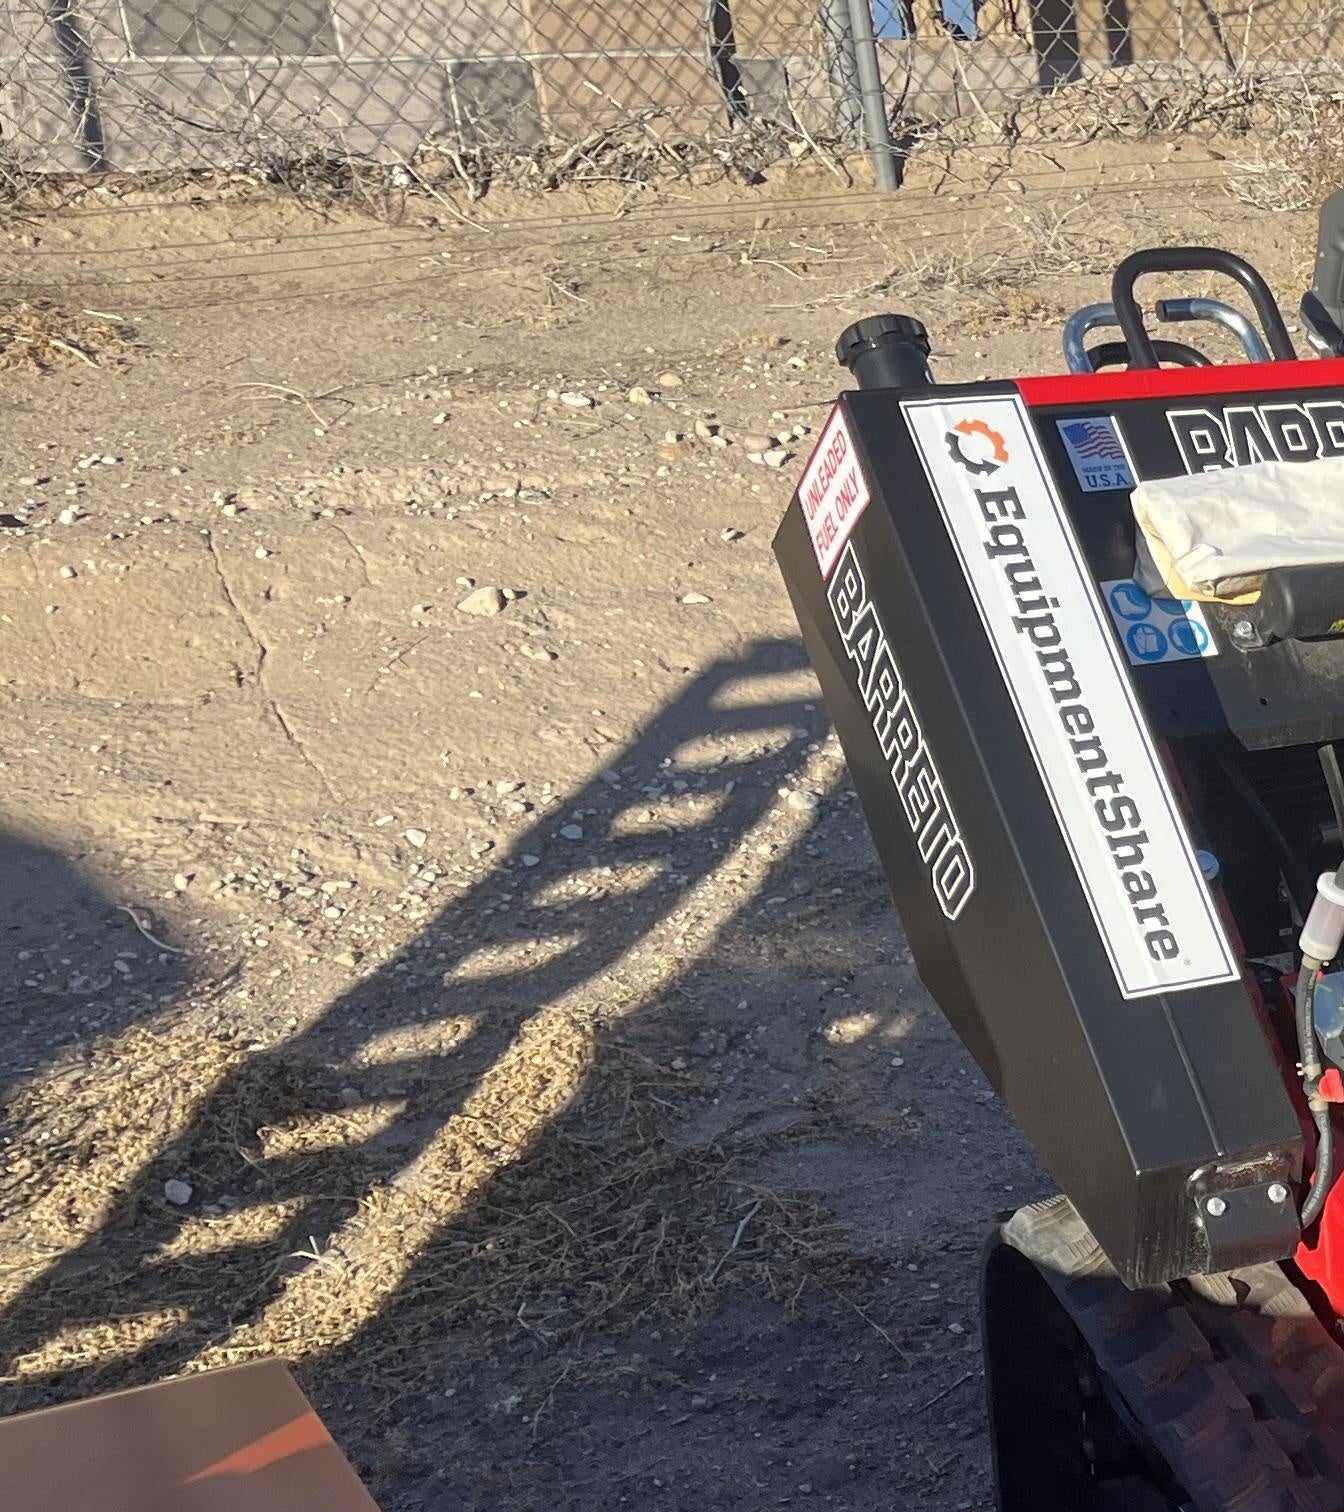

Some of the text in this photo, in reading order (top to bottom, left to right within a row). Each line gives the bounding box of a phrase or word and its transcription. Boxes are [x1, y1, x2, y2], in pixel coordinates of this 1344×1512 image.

[804, 429, 848, 521] UNLEADED
[815, 465, 860, 558] FUEL ONLY
[827, 539, 974, 921] BARRETO
[974, 485, 1181, 963] EquipmentShare
